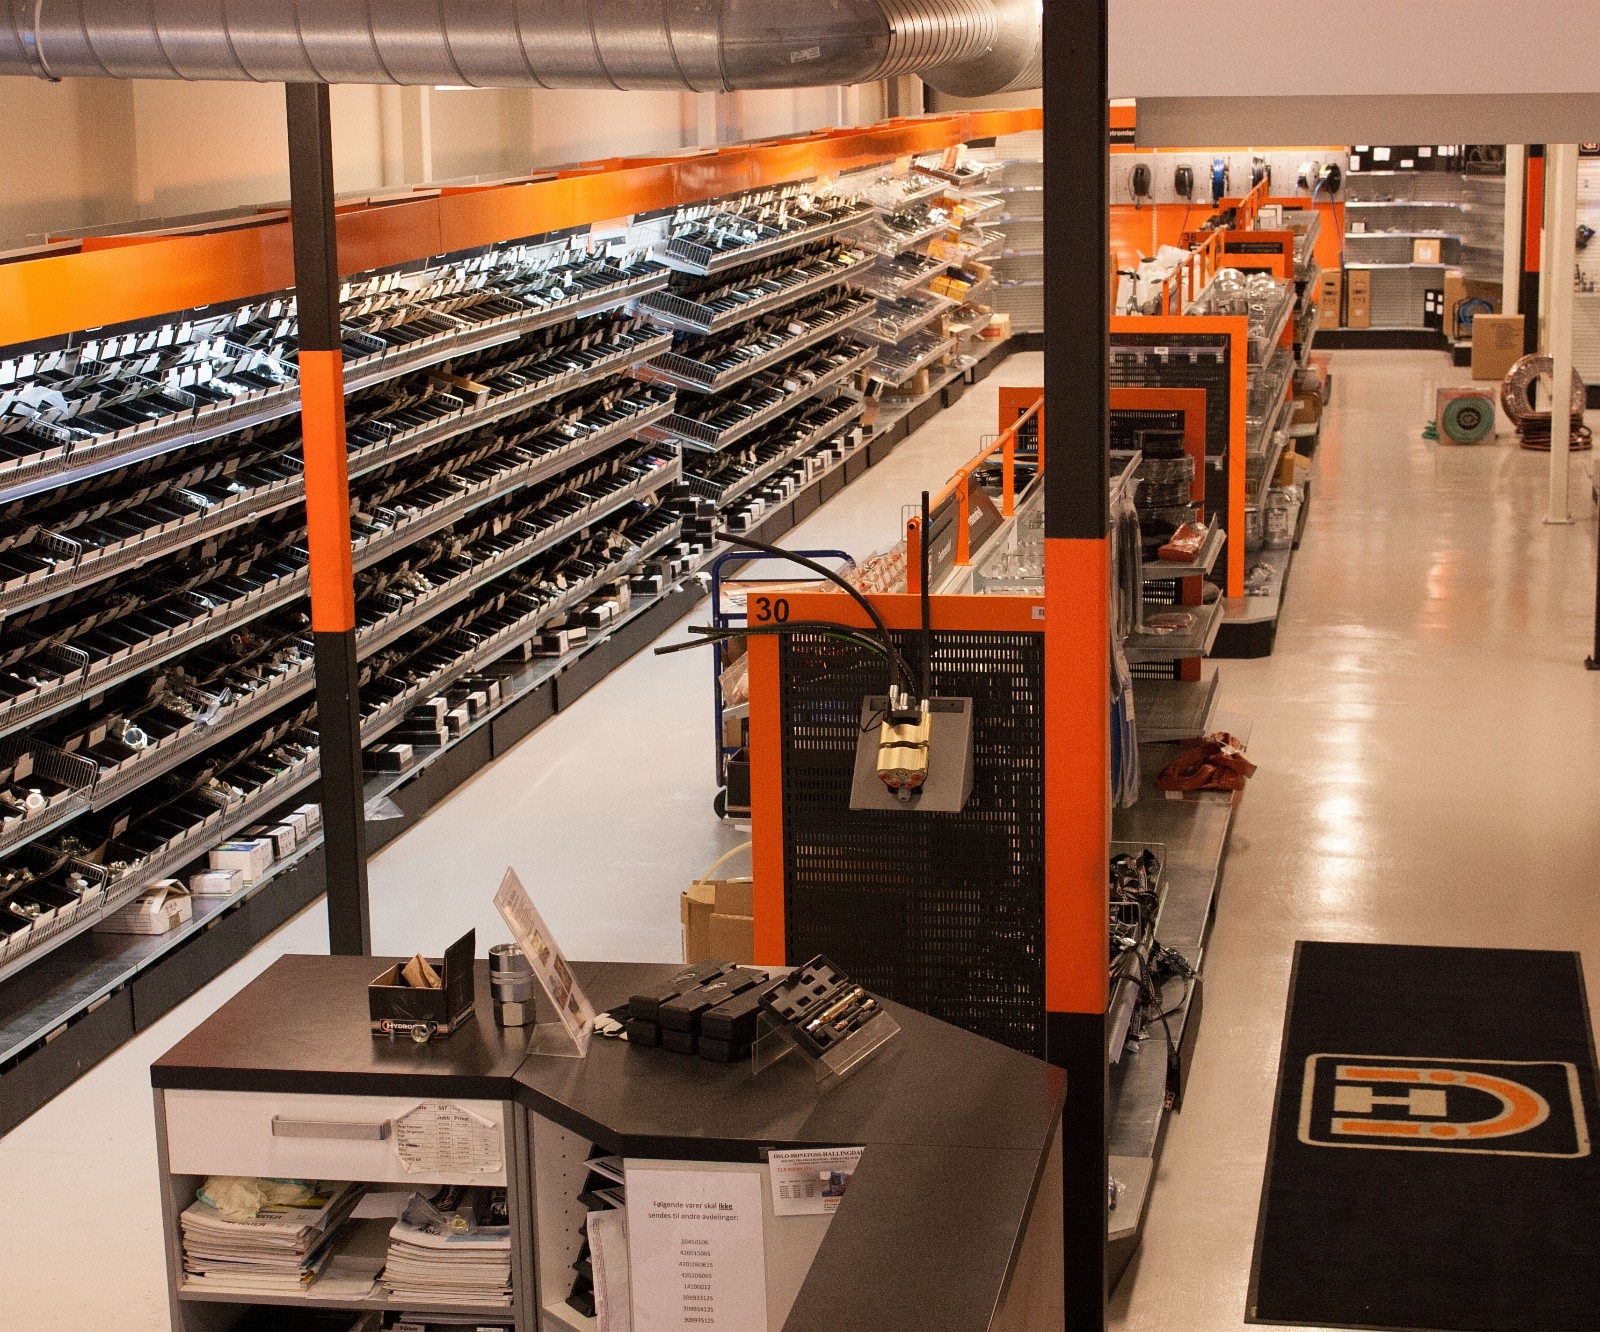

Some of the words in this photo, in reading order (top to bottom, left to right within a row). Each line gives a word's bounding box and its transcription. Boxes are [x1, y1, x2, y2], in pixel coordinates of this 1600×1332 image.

[1184, 232, 1197, 242] 36
[755, 597, 790, 623] 30
[653, 1200, 684, 1209] Følgende
[702, 1214, 740, 1222] avdelinger:
